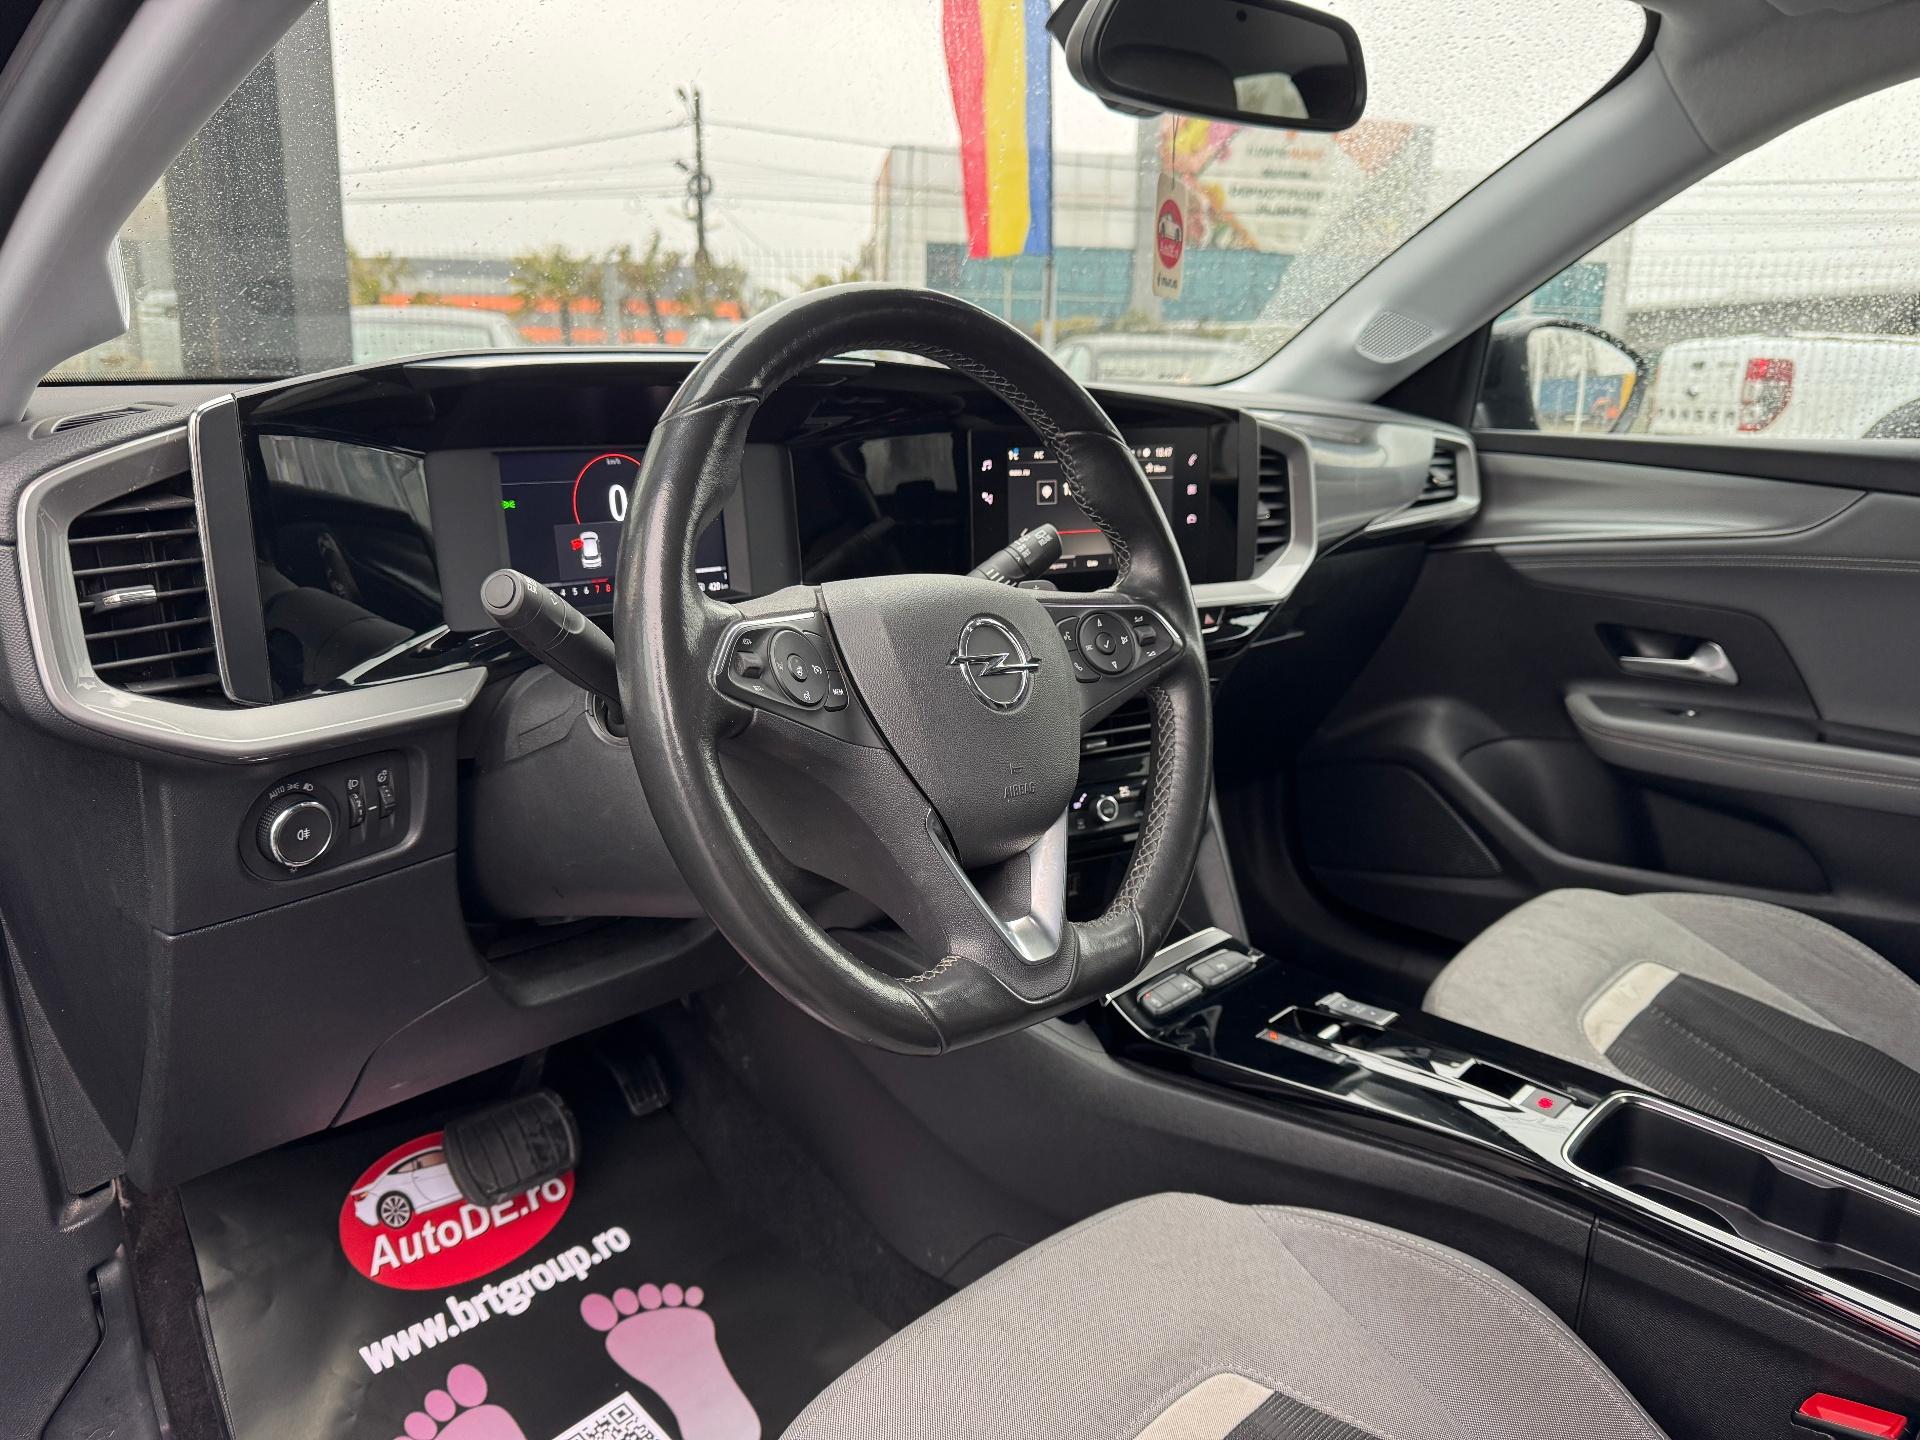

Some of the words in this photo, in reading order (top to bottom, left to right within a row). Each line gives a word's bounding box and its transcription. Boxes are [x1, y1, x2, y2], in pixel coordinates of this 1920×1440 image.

[608, 484, 628, 522] 0
[572, 587, 578, 596] 5
[584, 586, 590, 595] 6
[594, 584, 600, 593] 7
[605, 584, 612, 593] 8
[269, 785, 286, 800] AUTO
[359, 1226, 631, 1375] www.brtgroup.ro
